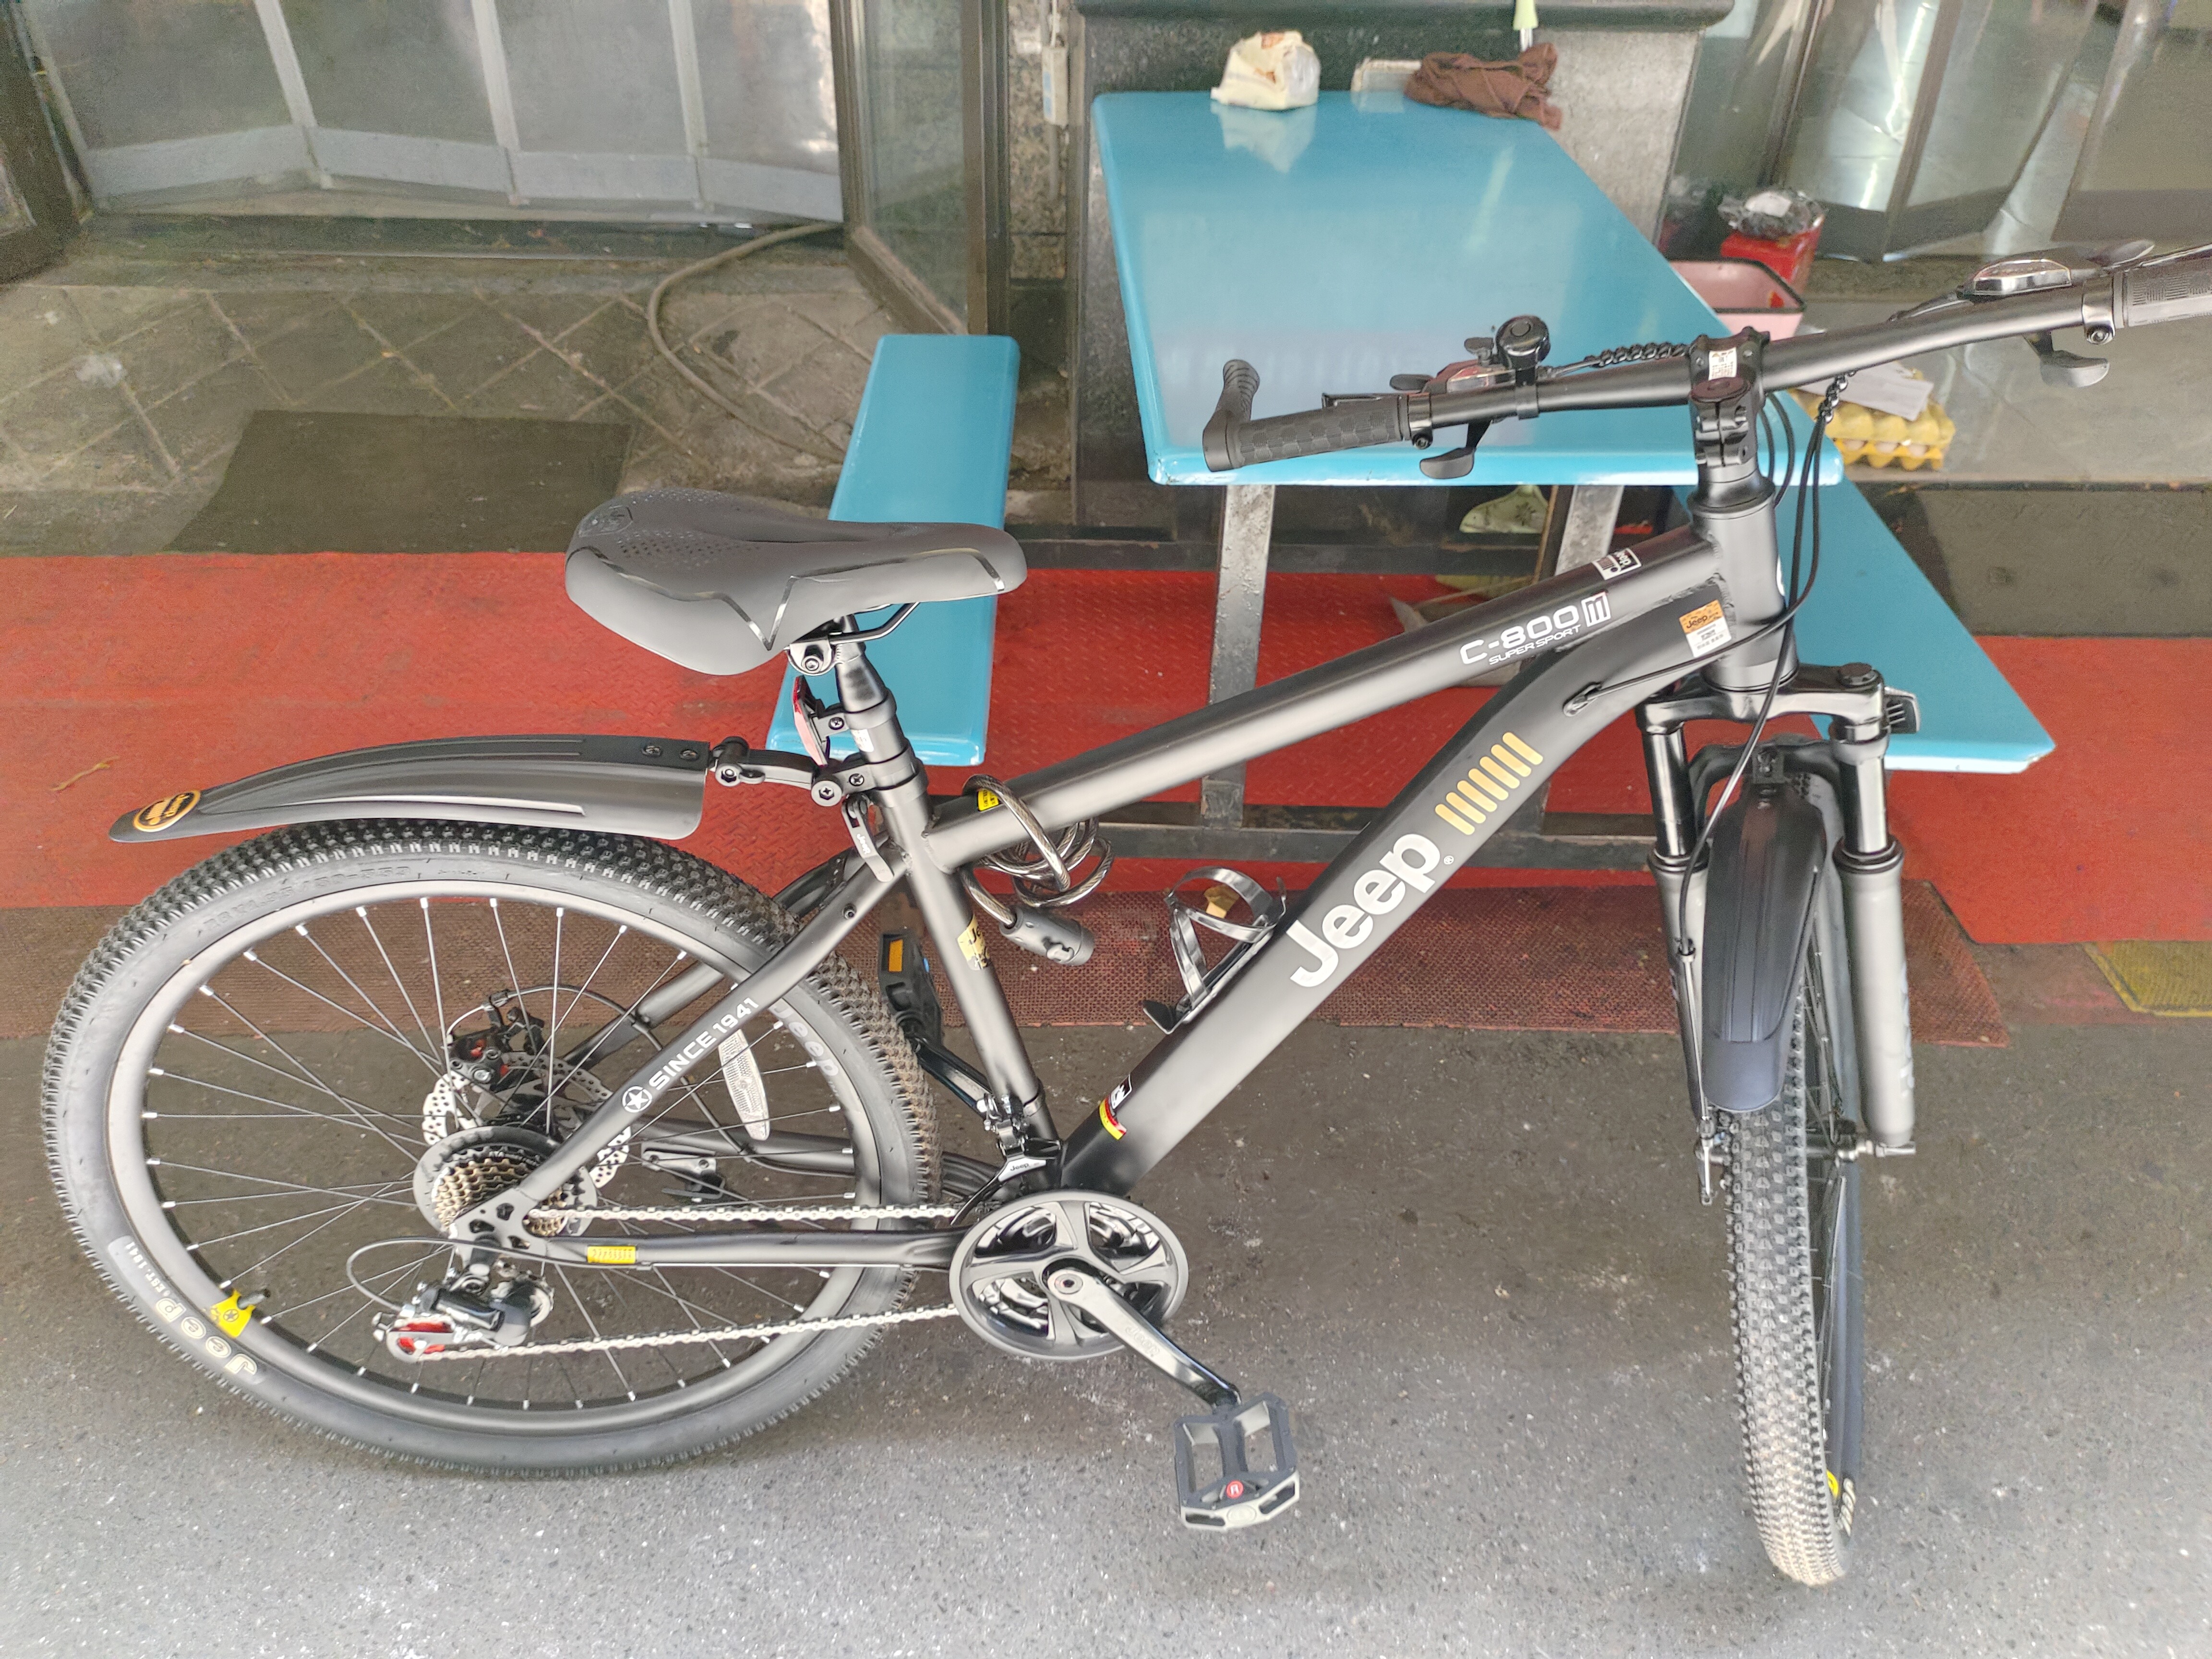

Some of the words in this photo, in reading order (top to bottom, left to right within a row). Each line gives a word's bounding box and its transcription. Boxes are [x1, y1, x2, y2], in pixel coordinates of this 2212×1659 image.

[1460, 605, 1579, 664] C-800
[1686, 615, 1707, 628] Jeep
[1489, 641, 1536, 665] SUPER
[1536, 624, 1581, 647] SPORT
[1286, 833, 1440, 987] Jeep
[649, 1031, 717, 1091] SINCE
[713, 997, 759, 1034] 1941
[769, 1001, 839, 1076] Jeep
[1010, 1163, 1029, 1171] Jeep
[125, 1241, 148, 1268] 1941
[145, 1268, 166, 1293] EST.
[156, 1297, 258, 1376] Jeep
[1125, 1325, 1160, 1355] Jeep
